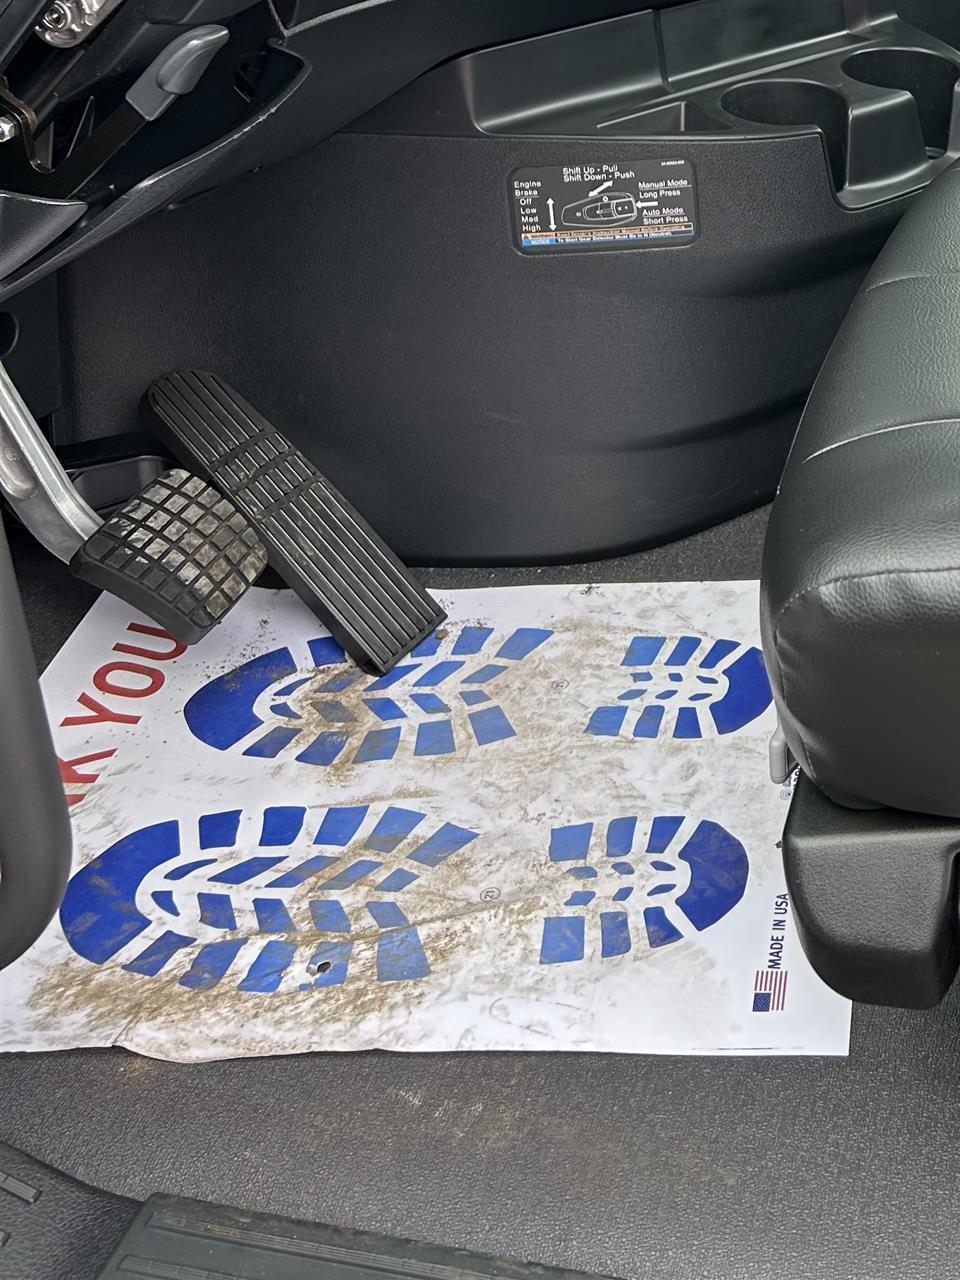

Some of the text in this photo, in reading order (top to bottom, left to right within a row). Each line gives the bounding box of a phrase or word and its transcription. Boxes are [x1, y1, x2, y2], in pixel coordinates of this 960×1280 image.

[562, 167, 581, 175] Shift
[583, 166, 595, 175] Up
[602, 164, 618, 173] Pull
[563, 174, 582, 183] Shift
[584, 173, 607, 181] Down
[614, 171, 635, 180] Push
[514, 180, 542, 190] Engine
[638, 179, 688, 189] Manual Mode
[514, 189, 538, 197] Brake
[640, 189, 681, 199] Long Press
[519, 198, 532, 206] Off
[520, 207, 537, 215] Low
[642, 207, 684, 217] Auto Mode
[521, 215, 539, 223] Med
[643, 215, 688, 225] Short Press
[522, 224, 541, 232] High
[59, 622, 188, 728] YOU
[767, 892, 790, 970] MADE IN USA
